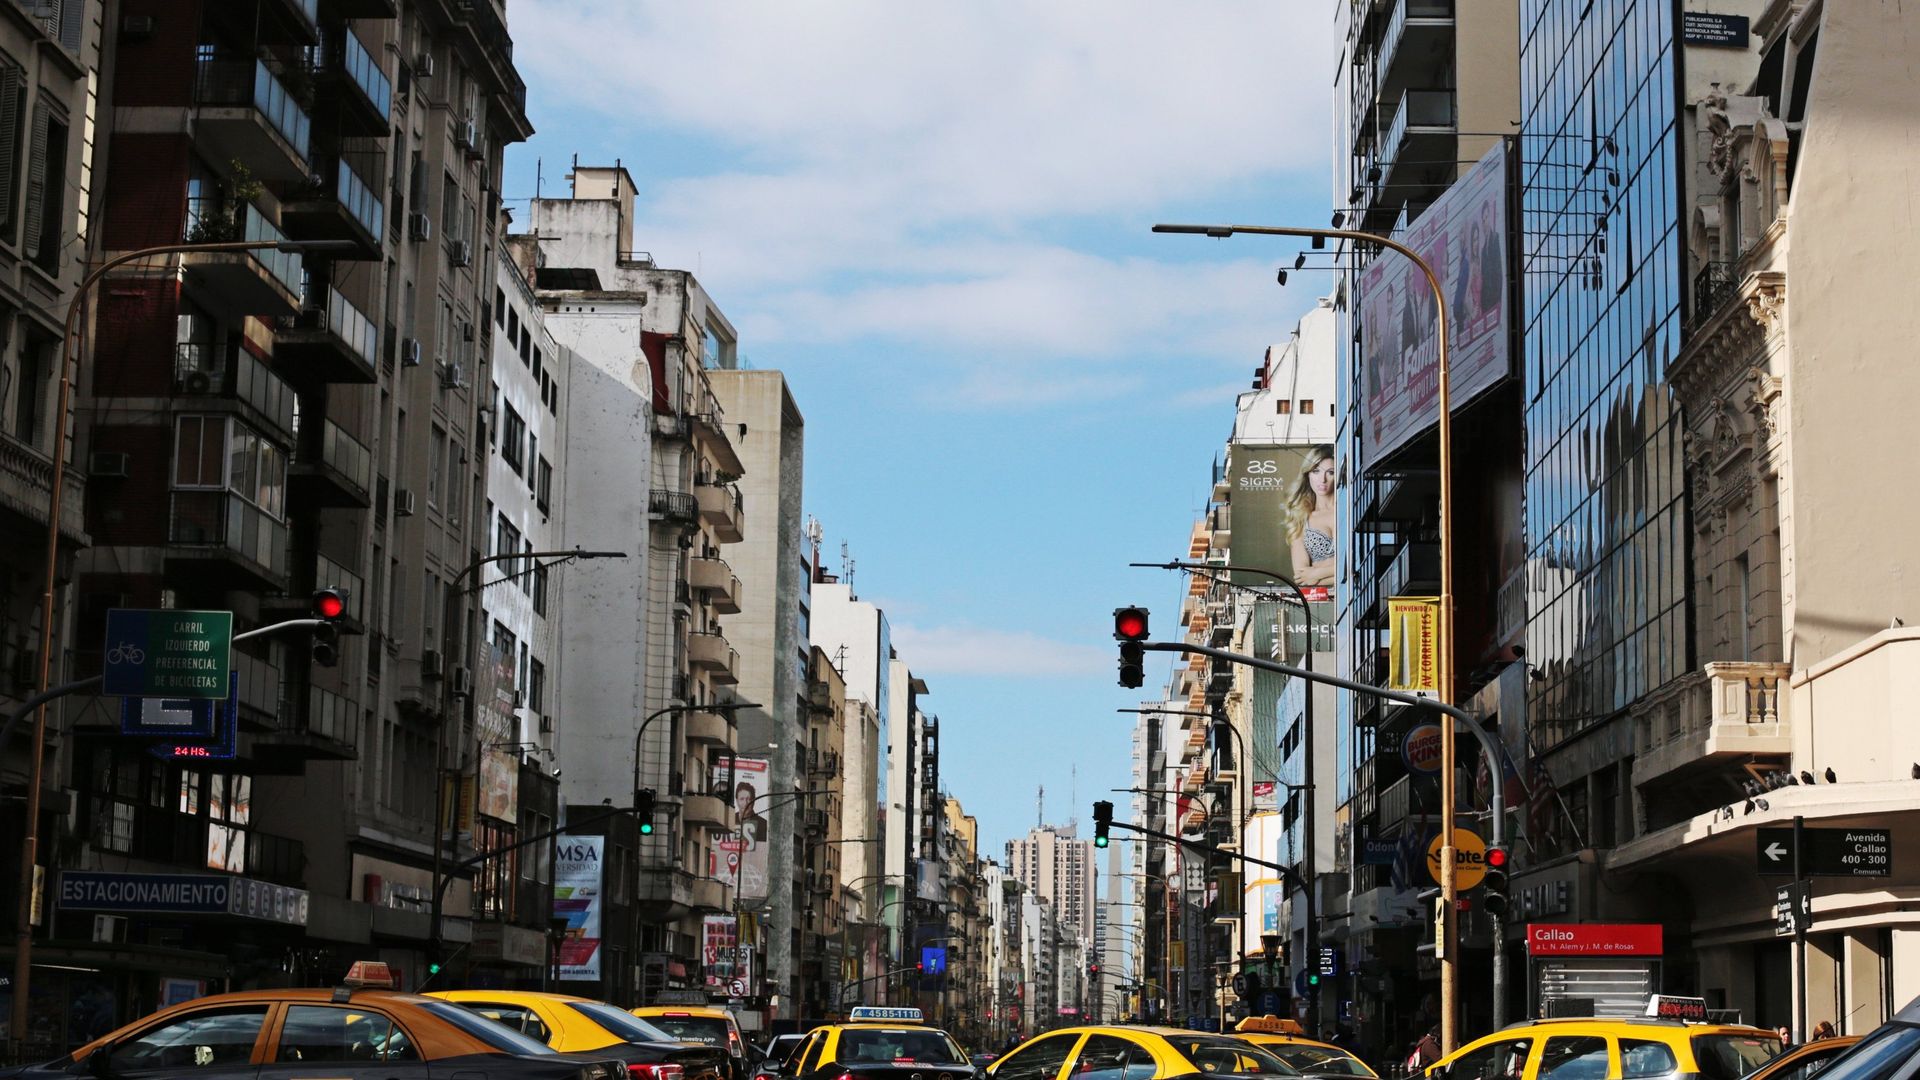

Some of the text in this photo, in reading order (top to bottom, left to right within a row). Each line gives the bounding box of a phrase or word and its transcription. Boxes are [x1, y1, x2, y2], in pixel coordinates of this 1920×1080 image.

[1240, 477, 1283, 486] SIGRY
[173, 622, 205, 634] CARRIL
[165, 640, 210, 652] IZQUIERDO
[155, 657, 217, 670] PREFERENCIAL
[154, 675, 217, 688] DE BICICLETAS
[174, 747, 210, 756] 24 HS.
[1845, 832, 1886, 842] Avenida
[556, 845, 598, 861] MSA
[1854, 844, 1887, 853] Callao
[1841, 855, 1861, 864] 400
[1868, 855, 1887, 864] 300
[62, 880, 227, 905] ESTACIONAMIENTO
[1535, 929, 1575, 941] Callao
[868, 1009, 920, 1018] 4585-1110
